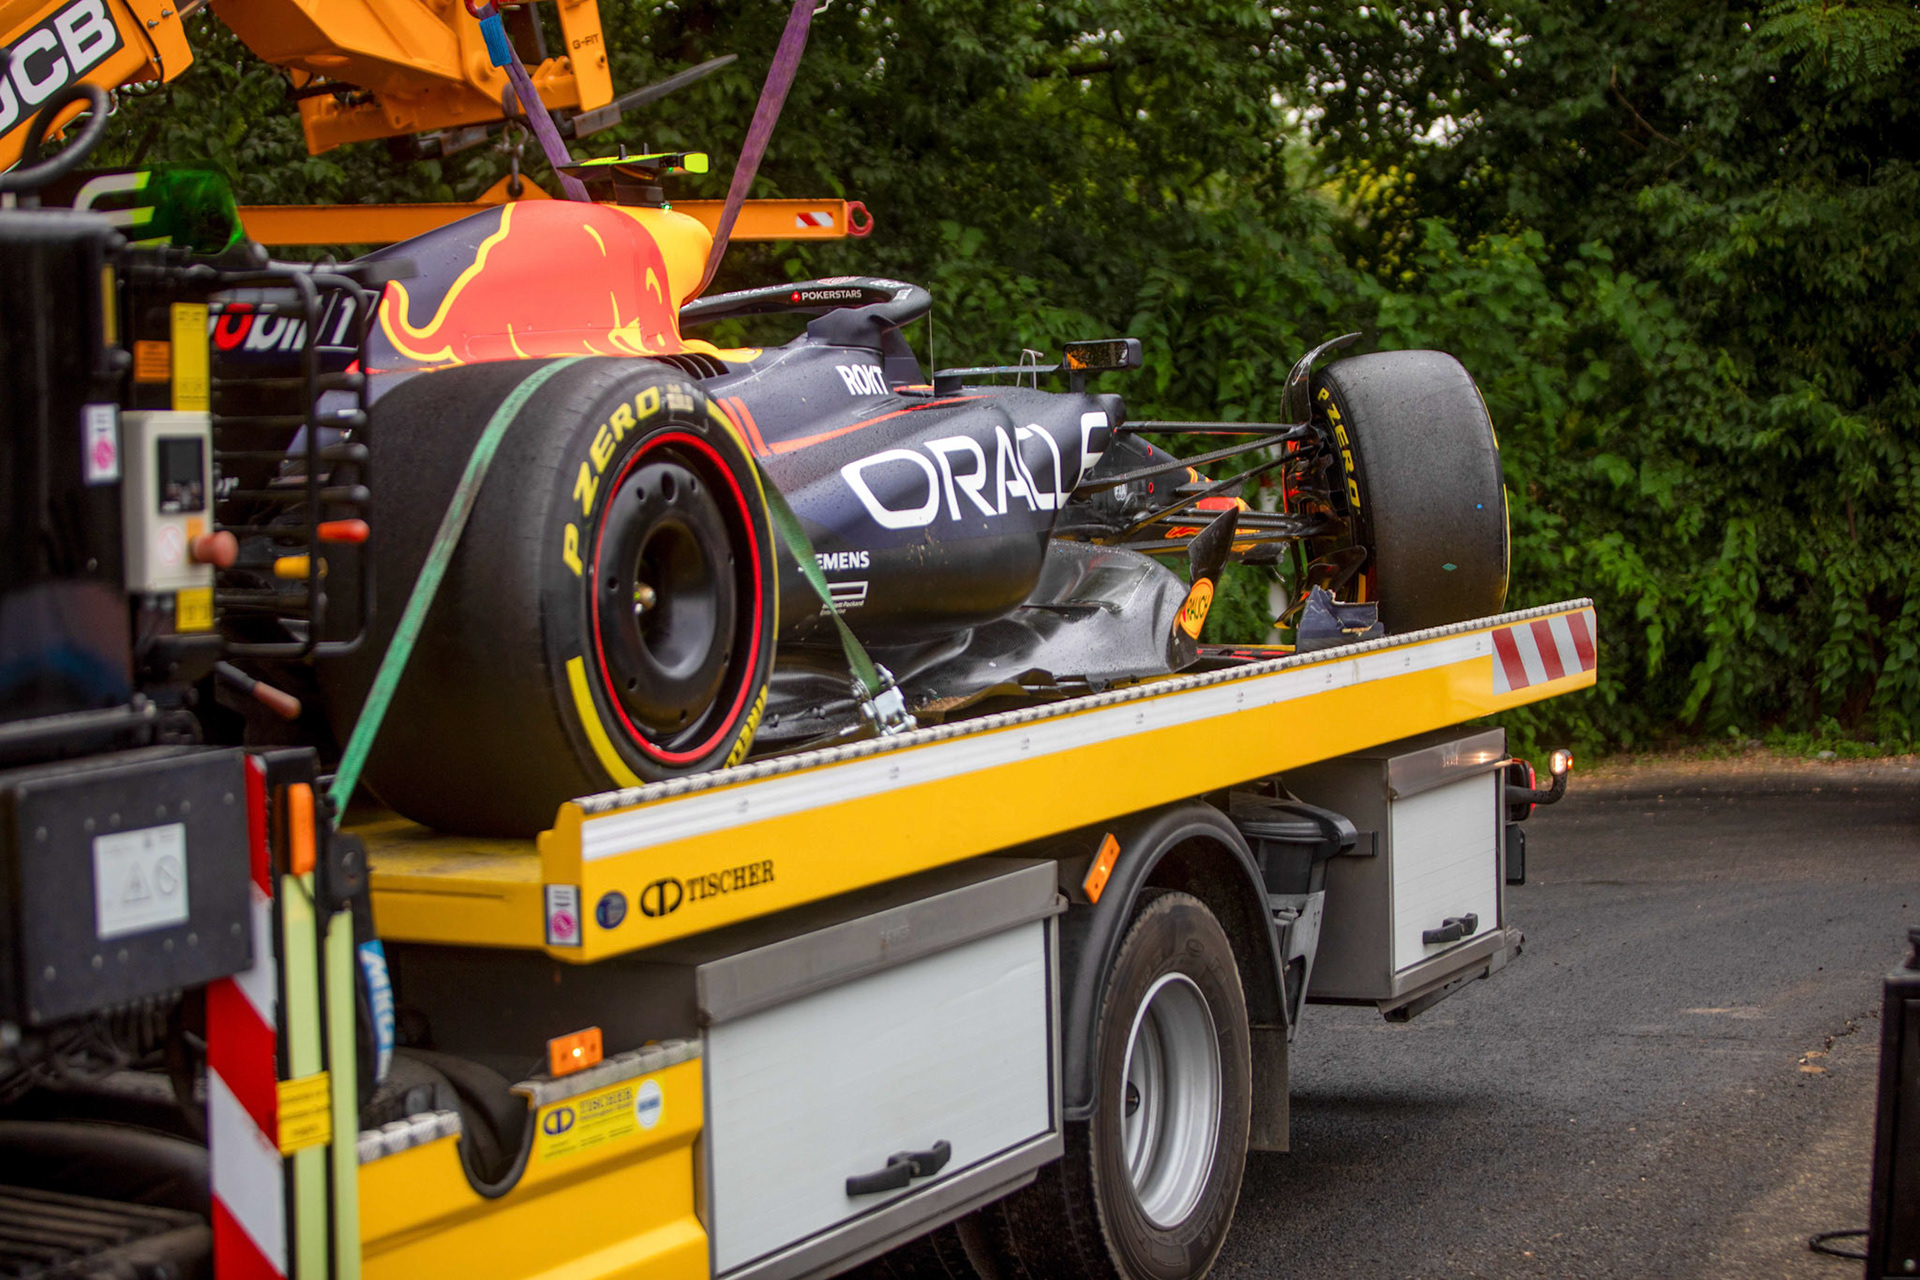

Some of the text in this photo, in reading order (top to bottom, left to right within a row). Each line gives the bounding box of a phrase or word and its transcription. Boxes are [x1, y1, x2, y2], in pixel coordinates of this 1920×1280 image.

[801, 289, 862, 301] POKERSTARS
[1317, 387, 1361, 508] P ZERO
[563, 386, 661, 577] P ZERO
[797, 550, 871, 573] EMENS
[686, 858, 775, 902] TISCHER
